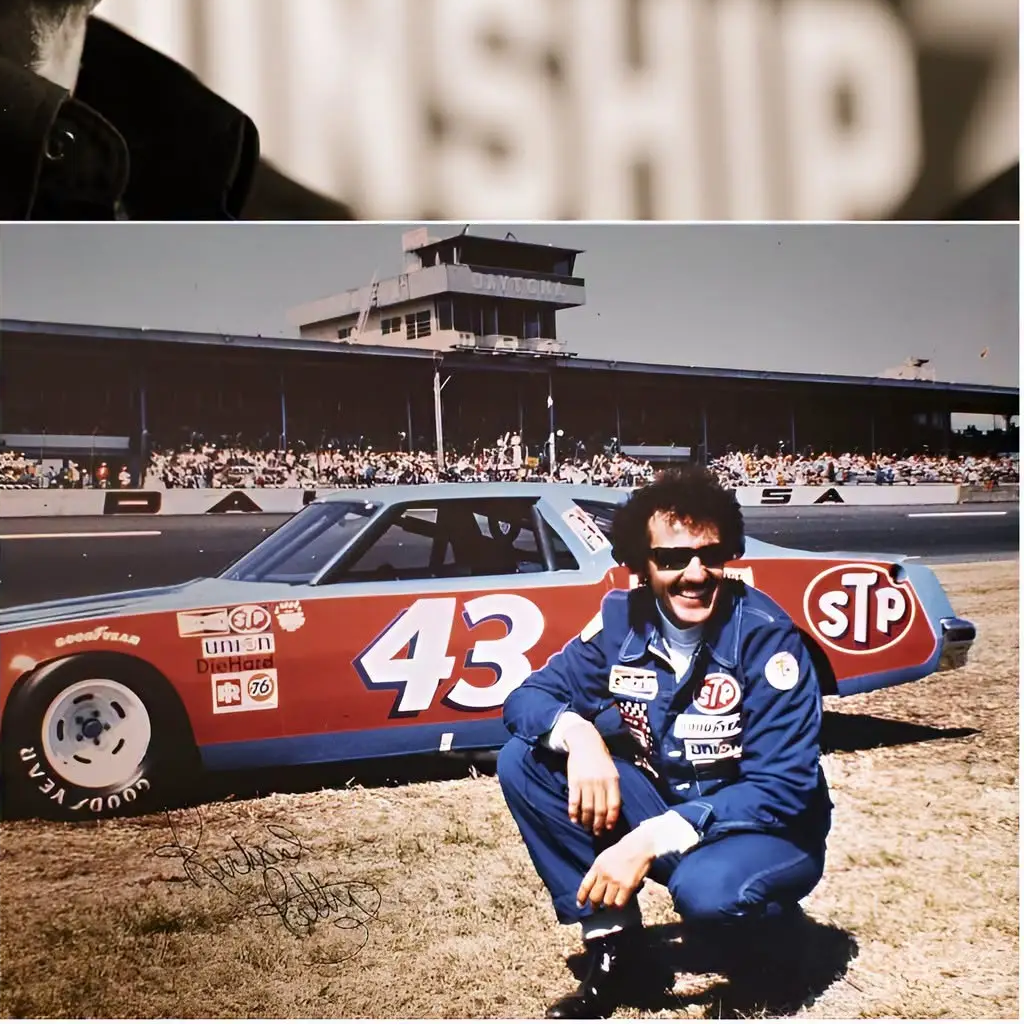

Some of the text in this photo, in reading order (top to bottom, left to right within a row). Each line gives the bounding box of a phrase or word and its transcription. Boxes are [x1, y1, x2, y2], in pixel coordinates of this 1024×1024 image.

[232, 606, 267, 630] STP
[817, 572, 907, 644] STP
[196, 656, 274, 674] DieHard
[351, 593, 546, 720] 43
[697, 676, 736, 707] STP
